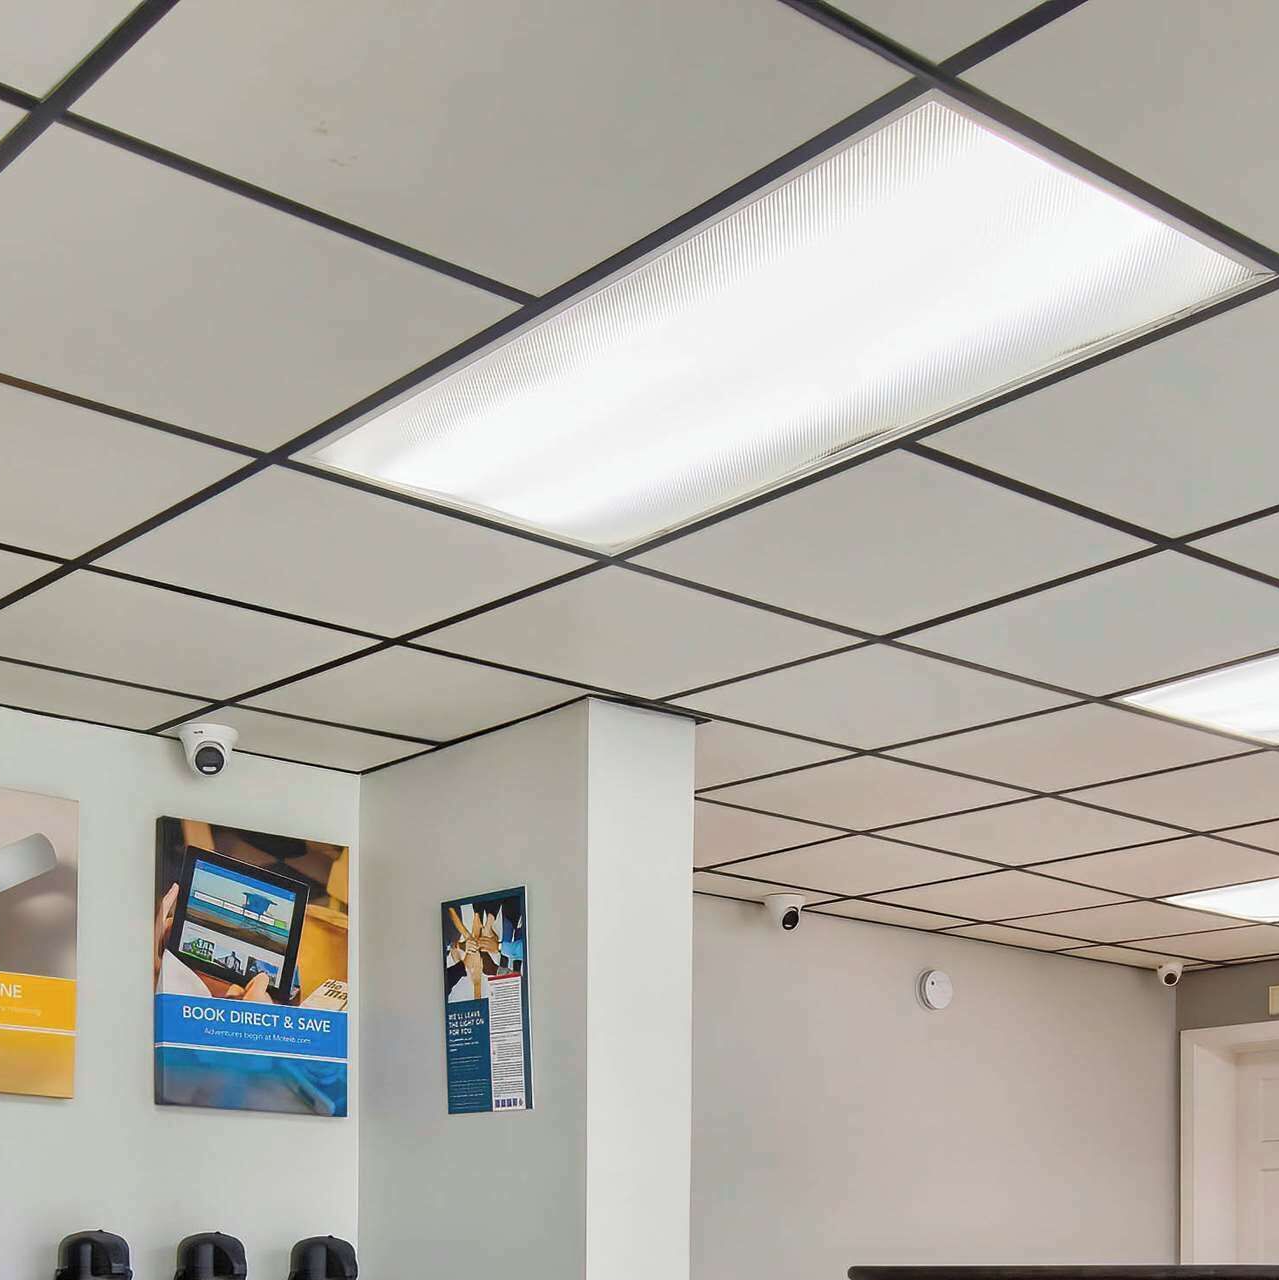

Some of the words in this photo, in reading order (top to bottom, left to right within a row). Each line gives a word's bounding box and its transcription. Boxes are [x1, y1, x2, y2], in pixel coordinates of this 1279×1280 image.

[323, 979, 343, 990] the
[182, 1005, 226, 1023] BOOK
[230, 1010, 280, 1029] DIRECT
[284, 1016, 294, 1029] &
[297, 1018, 331, 1033] SAVE
